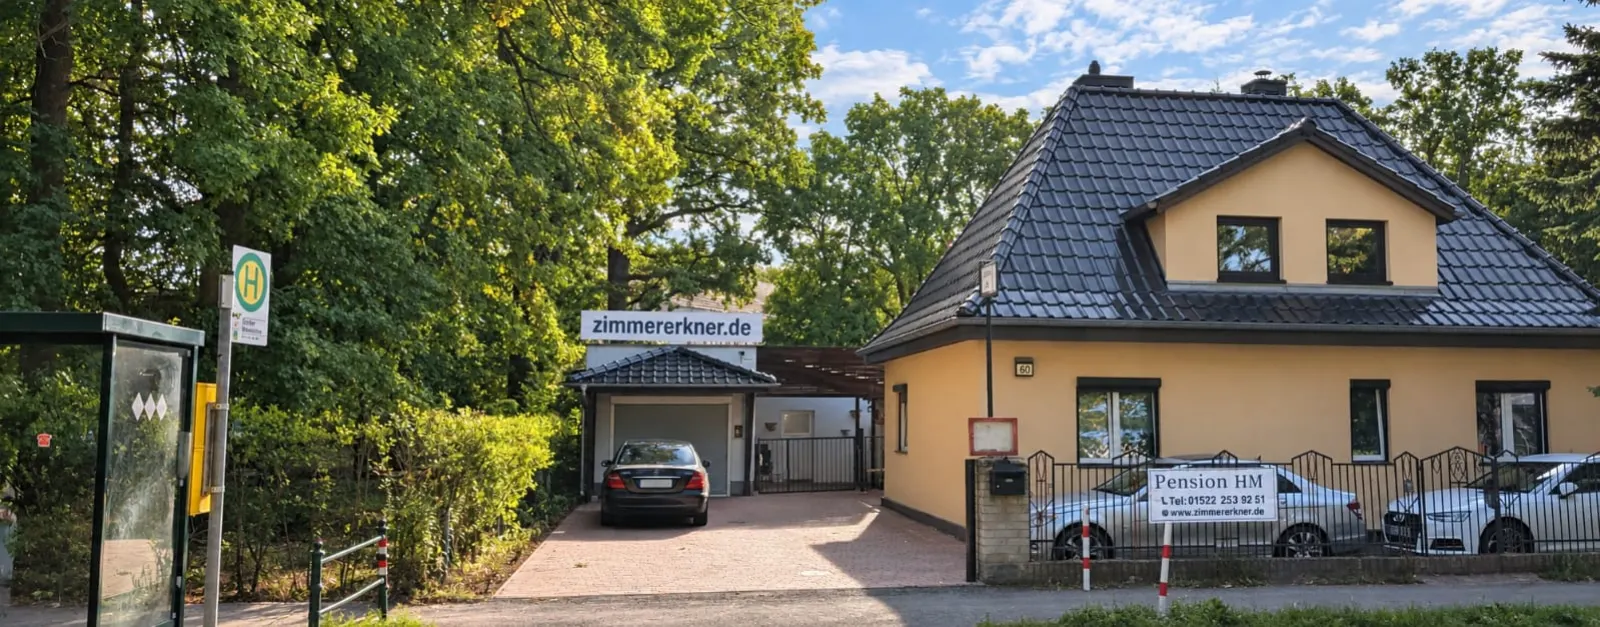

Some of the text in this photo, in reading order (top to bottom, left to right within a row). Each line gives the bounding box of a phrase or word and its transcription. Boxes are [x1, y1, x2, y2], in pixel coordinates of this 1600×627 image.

[244, 264, 258, 300] H
[592, 315, 751, 336] zimmererkner.de
[1020, 365, 1030, 373] 60
[1154, 473, 1263, 489] Pension HM
[1220, 495, 1238, 504] 253
[1241, 495, 1252, 504] 92
[1255, 495, 1265, 504] 51
[1170, 507, 1264, 517] www.zimmererkner.de
